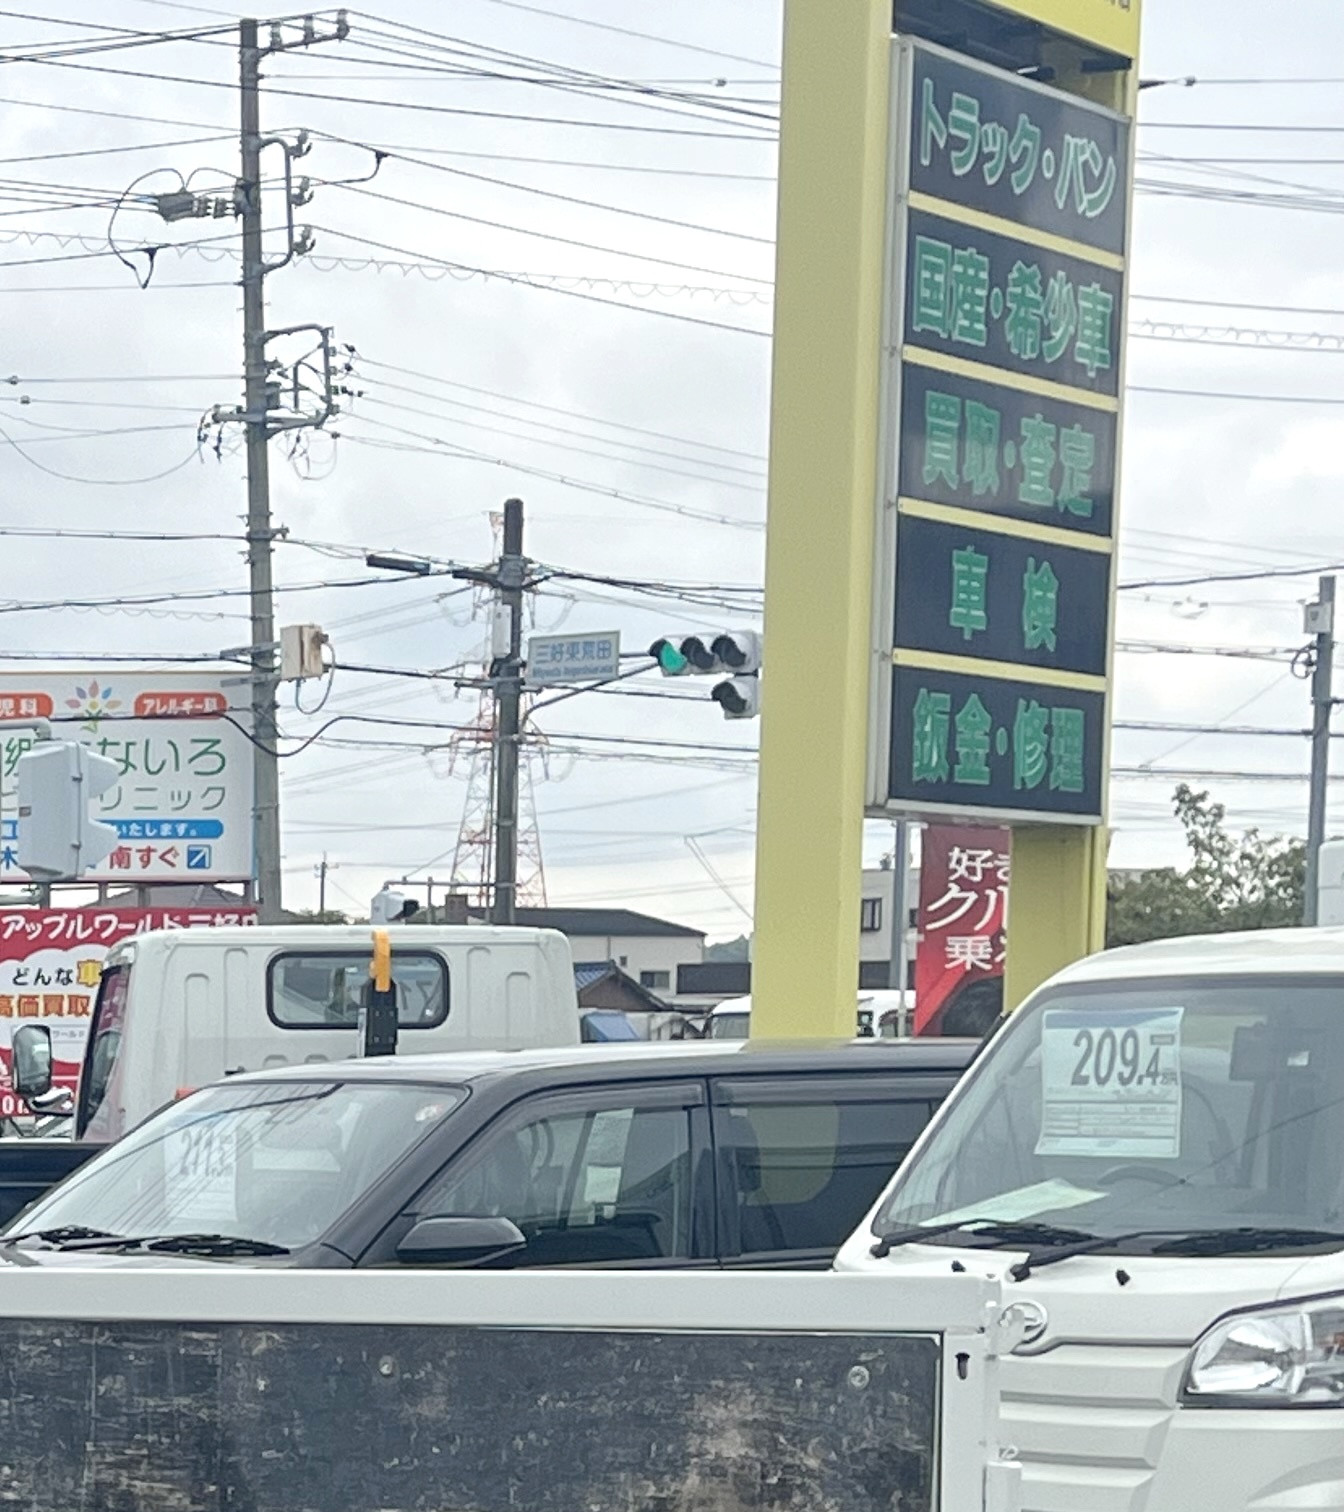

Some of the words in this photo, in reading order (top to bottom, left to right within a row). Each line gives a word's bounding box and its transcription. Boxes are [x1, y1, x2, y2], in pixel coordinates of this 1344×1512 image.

[920, 77, 1116, 218] トラック・バン
[913, 235, 1113, 378] 国産・希少車
[922, 390, 1094, 517] 買取・査定
[912, 687, 1084, 793] 鈑金・修理
[944, 934, 1008, 971] 乗
